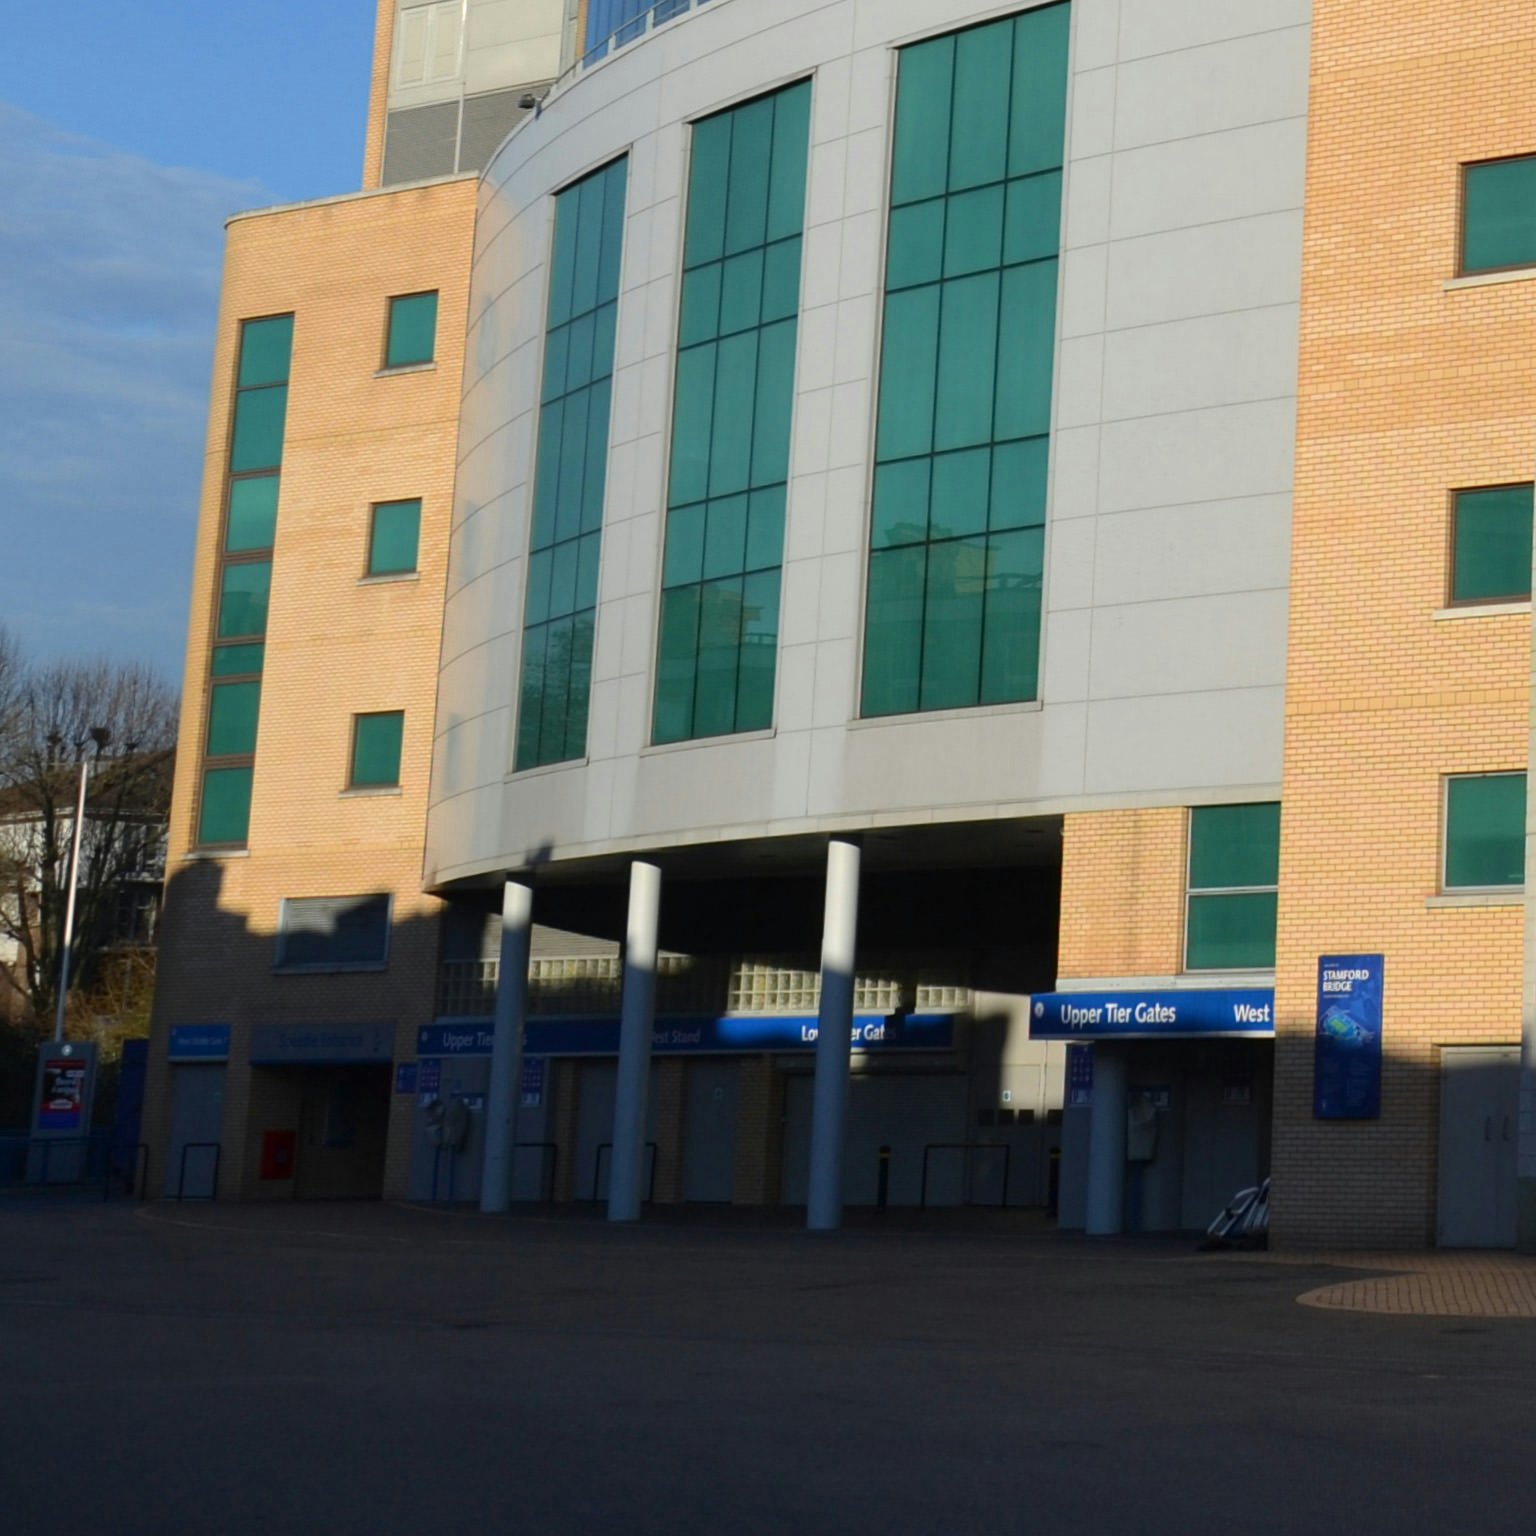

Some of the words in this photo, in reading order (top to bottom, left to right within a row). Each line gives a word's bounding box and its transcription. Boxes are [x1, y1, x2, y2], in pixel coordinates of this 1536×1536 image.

[1323, 969, 1369, 981] STAMFORD
[1323, 981, 1352, 992] BRIDGE
[1060, 1004, 1103, 1029] Upper
[1105, 1002, 1132, 1024] Tier
[1135, 1002, 1177, 1024] Gates
[1233, 1004, 1271, 1024] West
[442, 1032, 474, 1049] Upper
[651, 1030, 669, 1044] est
[672, 1027, 701, 1044] Stand
